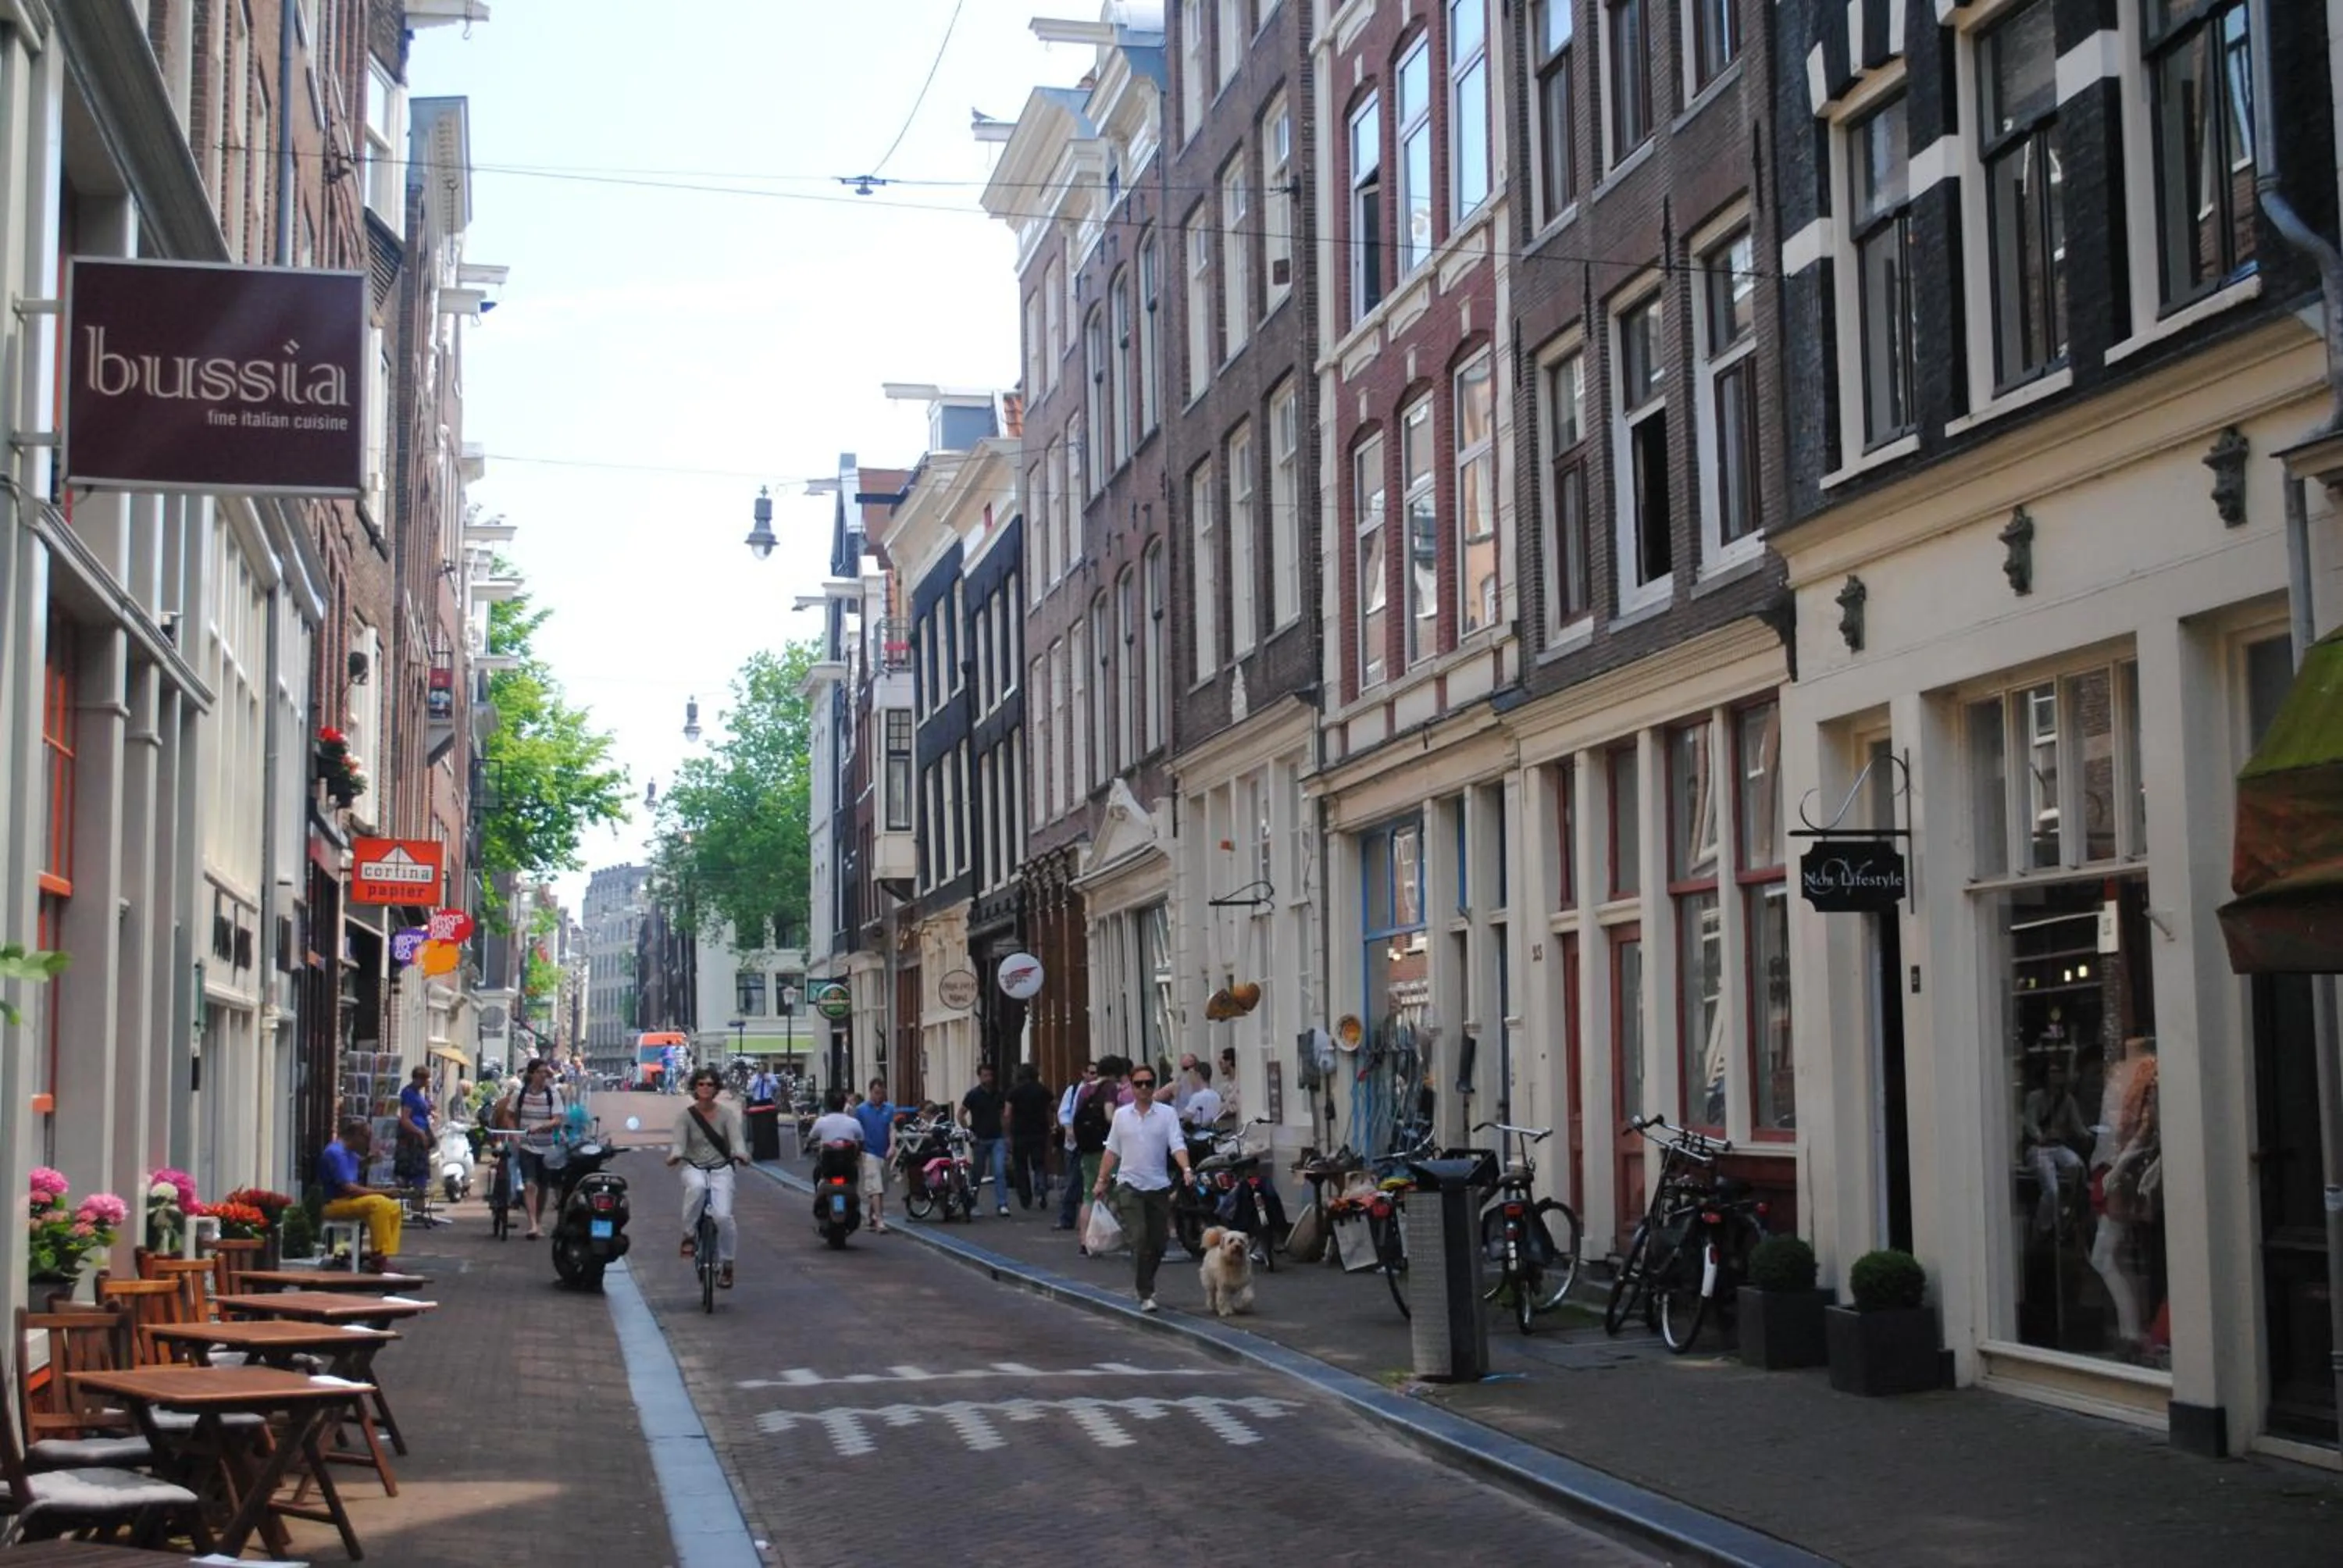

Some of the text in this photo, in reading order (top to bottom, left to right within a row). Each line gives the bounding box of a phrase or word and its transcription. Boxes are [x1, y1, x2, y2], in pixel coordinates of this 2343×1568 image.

[84, 325, 350, 406] bussia
[208, 409, 348, 430] fine italian cuisine
[364, 866, 430, 880] cortina
[1840, 870, 1903, 888] Lifestyle
[367, 884, 426, 900] papier
